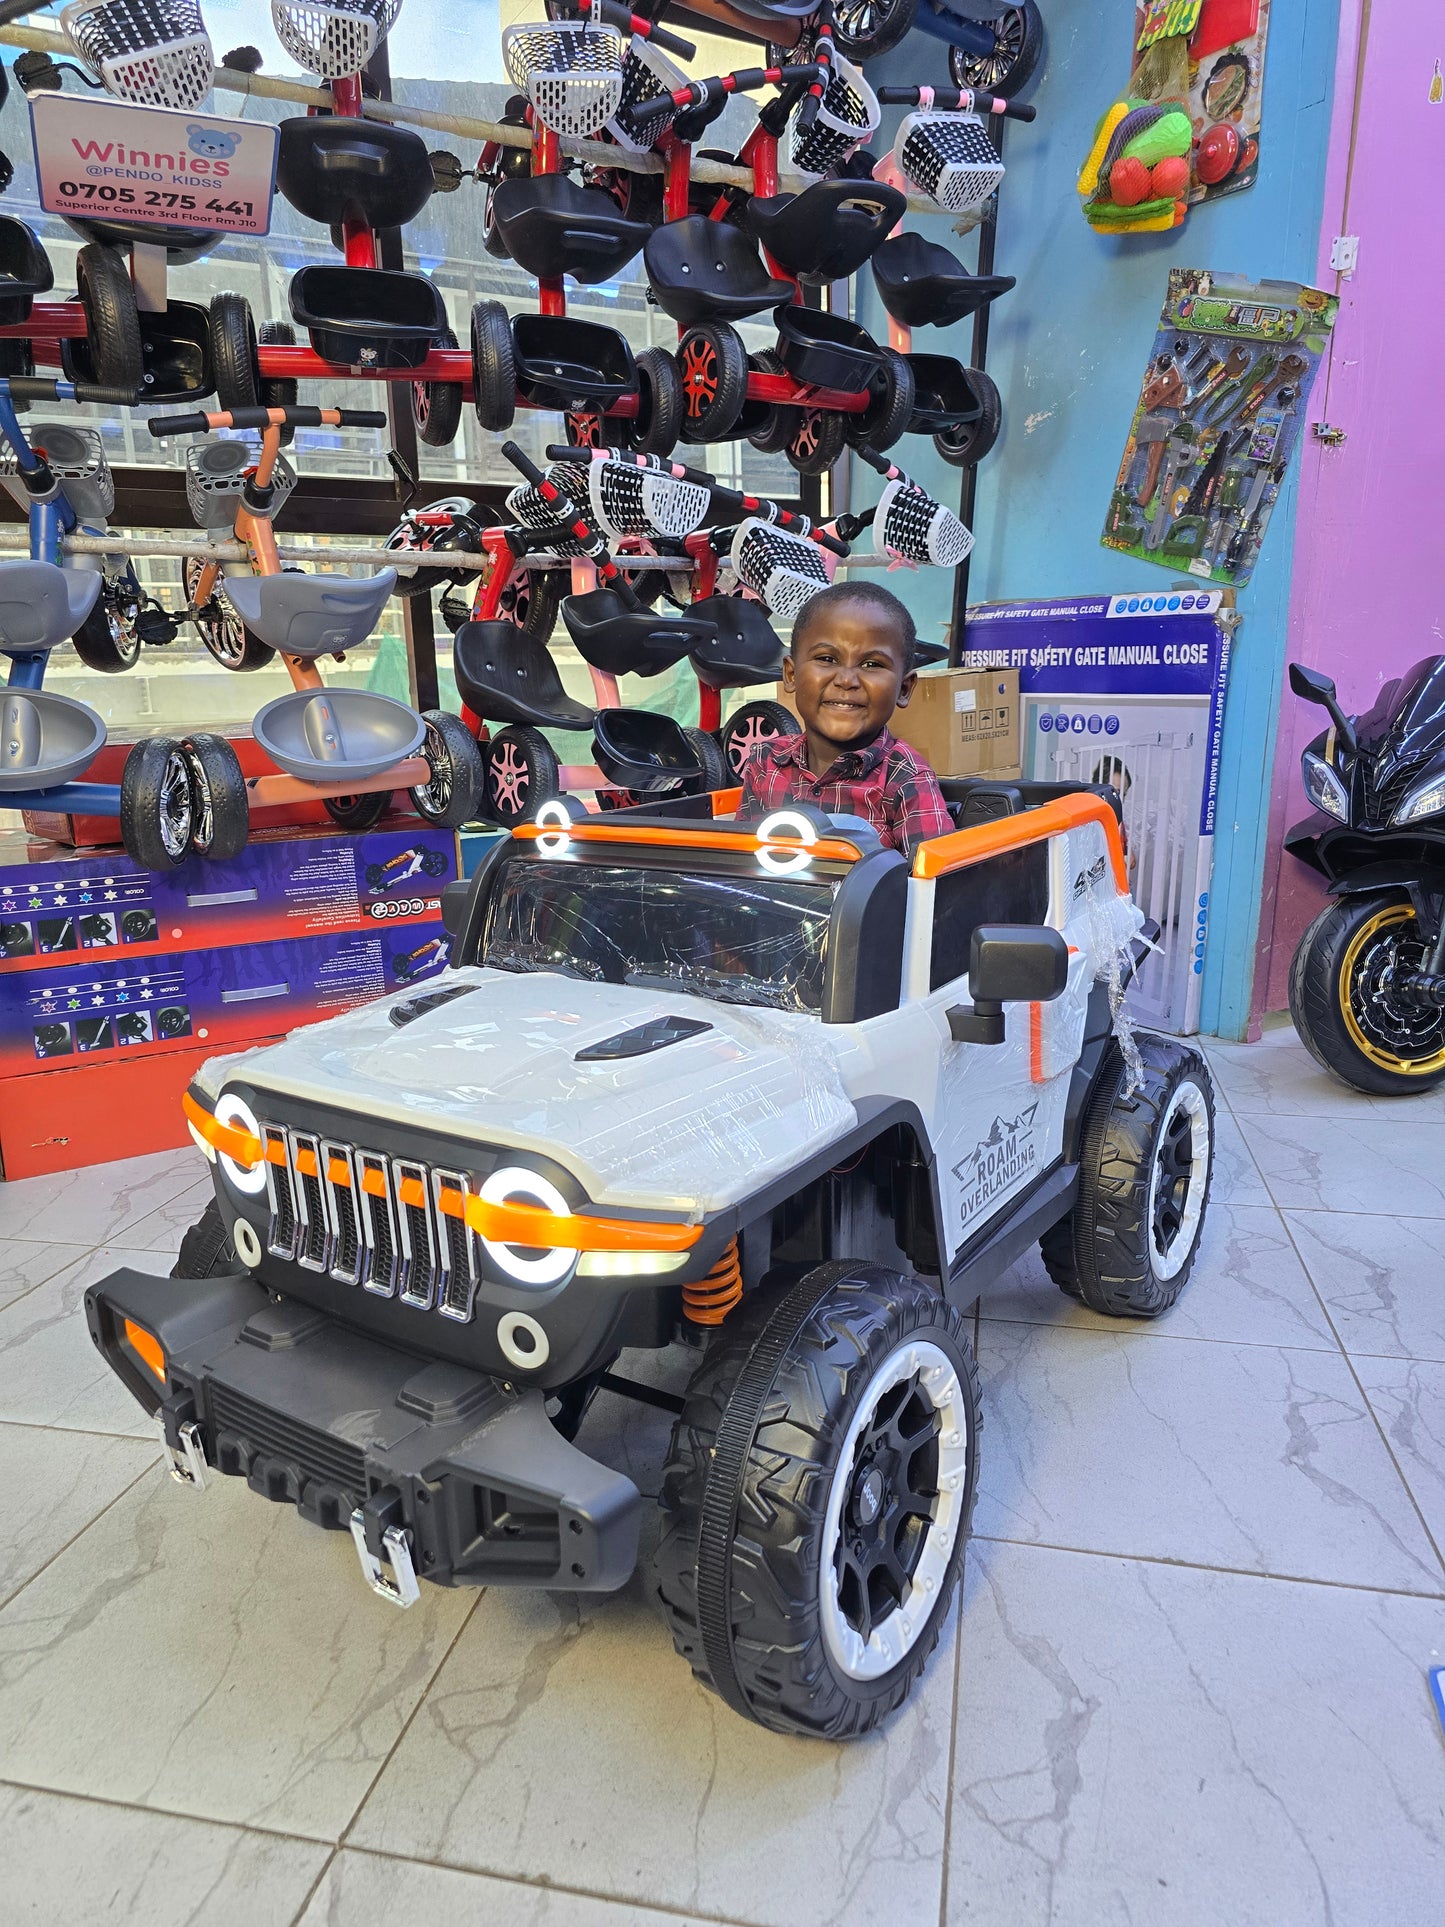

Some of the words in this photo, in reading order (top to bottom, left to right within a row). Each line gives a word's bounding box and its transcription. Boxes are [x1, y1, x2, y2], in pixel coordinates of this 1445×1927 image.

[72, 138, 231, 177] Winnies
[86, 165, 222, 189] @PENDO_KIDSS
[55, 199, 111, 213] Superior
[113, 205, 155, 217] Centre
[158, 209, 178, 220] 3rd
[182, 212, 213, 224] Floor
[215, 216, 236, 226] Rm
[238, 219, 257, 228] J10
[59, 181, 135, 203] 0705
[145, 190, 196, 210] 275
[205, 199, 253, 217] 441
[1005, 609, 1031, 619] SAFETY
[1031, 608, 1049, 617] GATE
[1049, 606, 1078, 616] MANUAL
[1079, 604, 1104, 614] CLOSE
[1011, 648, 1028, 667] FIT
[1030, 647, 1073, 667] SAFETY
[1074, 646, 1106, 666] GATE
[1108, 645, 1160, 665] MANUAL
[1163, 644, 1209, 665] CLOSE
[1219, 632, 1232, 671] ESSURE
[1217, 672, 1227, 689] FIT
[1215, 691, 1225, 728] SAFETY
[1212, 730, 1221, 756] GATE
[1208, 758, 1219, 799] MANUAL
[1205, 800, 1214, 831] CLOSE
[977, 1134, 1017, 1185] ROAM
[960, 1144, 1035, 1221] OVERLANDING
